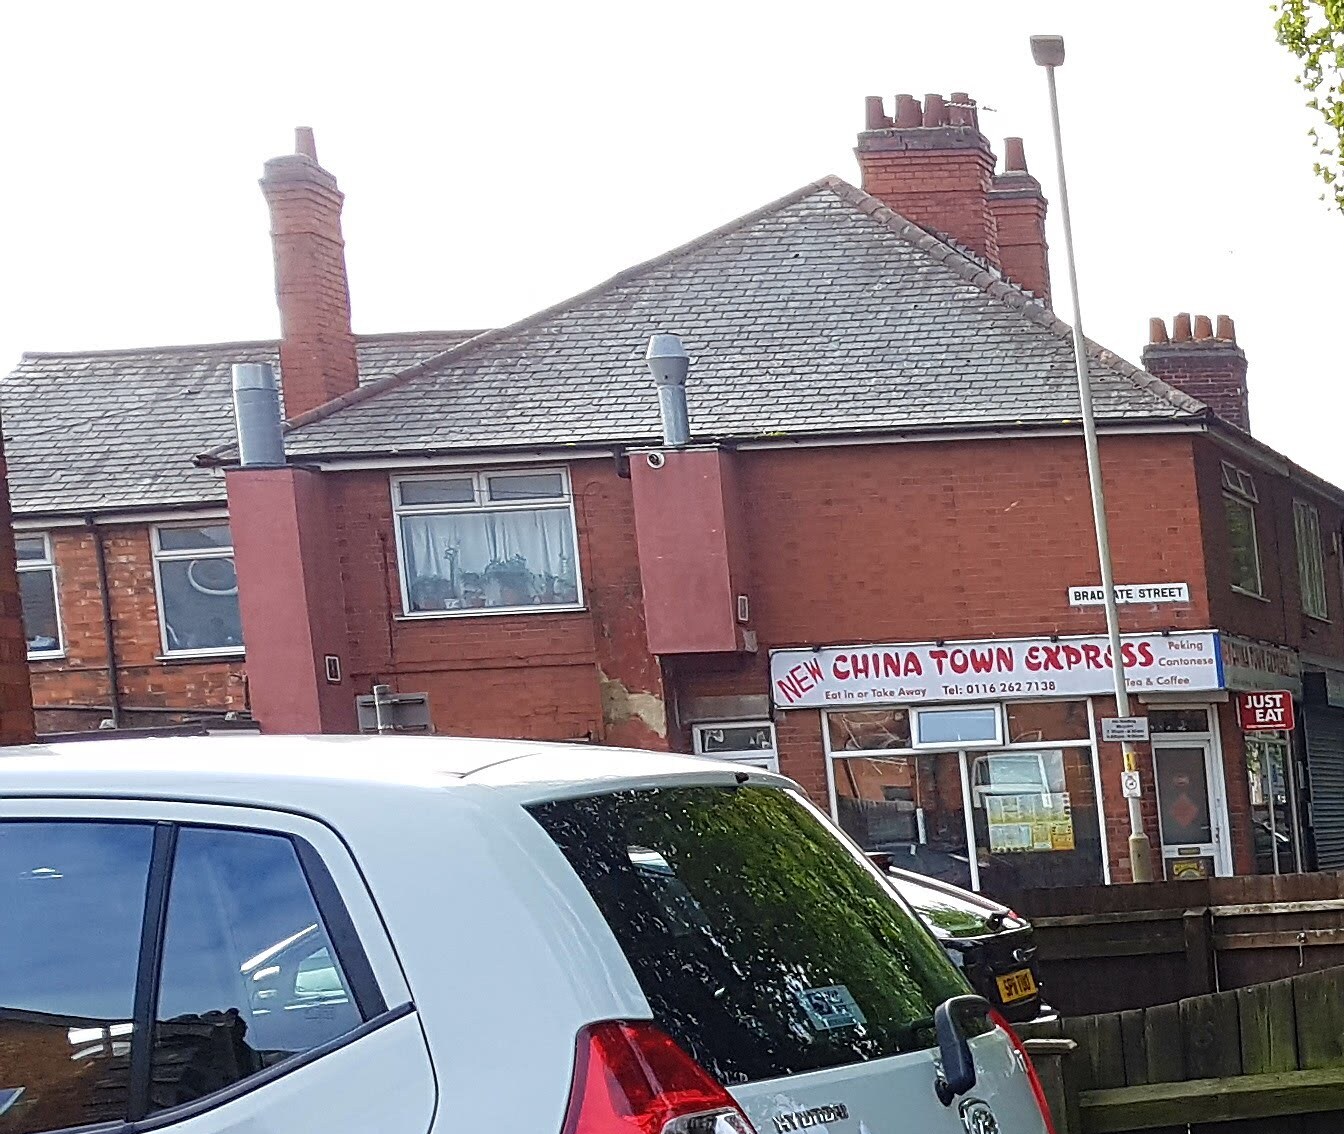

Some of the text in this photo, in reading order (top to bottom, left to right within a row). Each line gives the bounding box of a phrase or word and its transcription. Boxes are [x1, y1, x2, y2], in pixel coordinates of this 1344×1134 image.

[1074, 587, 1183, 601] BRADATE STREET
[1168, 640, 1203, 652] Peking
[1159, 656, 1213, 667] Cantonese
[776, 657, 824, 703] NEW
[833, 651, 922, 680] CHINA
[929, 646, 1014, 675] TOWN
[1146, 677, 1153, 686] &
[1157, 675, 1190, 686] Coffee
[825, 690, 841, 699] Eat
[871, 688, 895, 698] Take
[898, 687, 927, 699] Away
[942, 681, 1056, 695] Tel: 0116 262 7138
[1245, 694, 1283, 709] JUST
[1256, 708, 1284, 722] EAT
